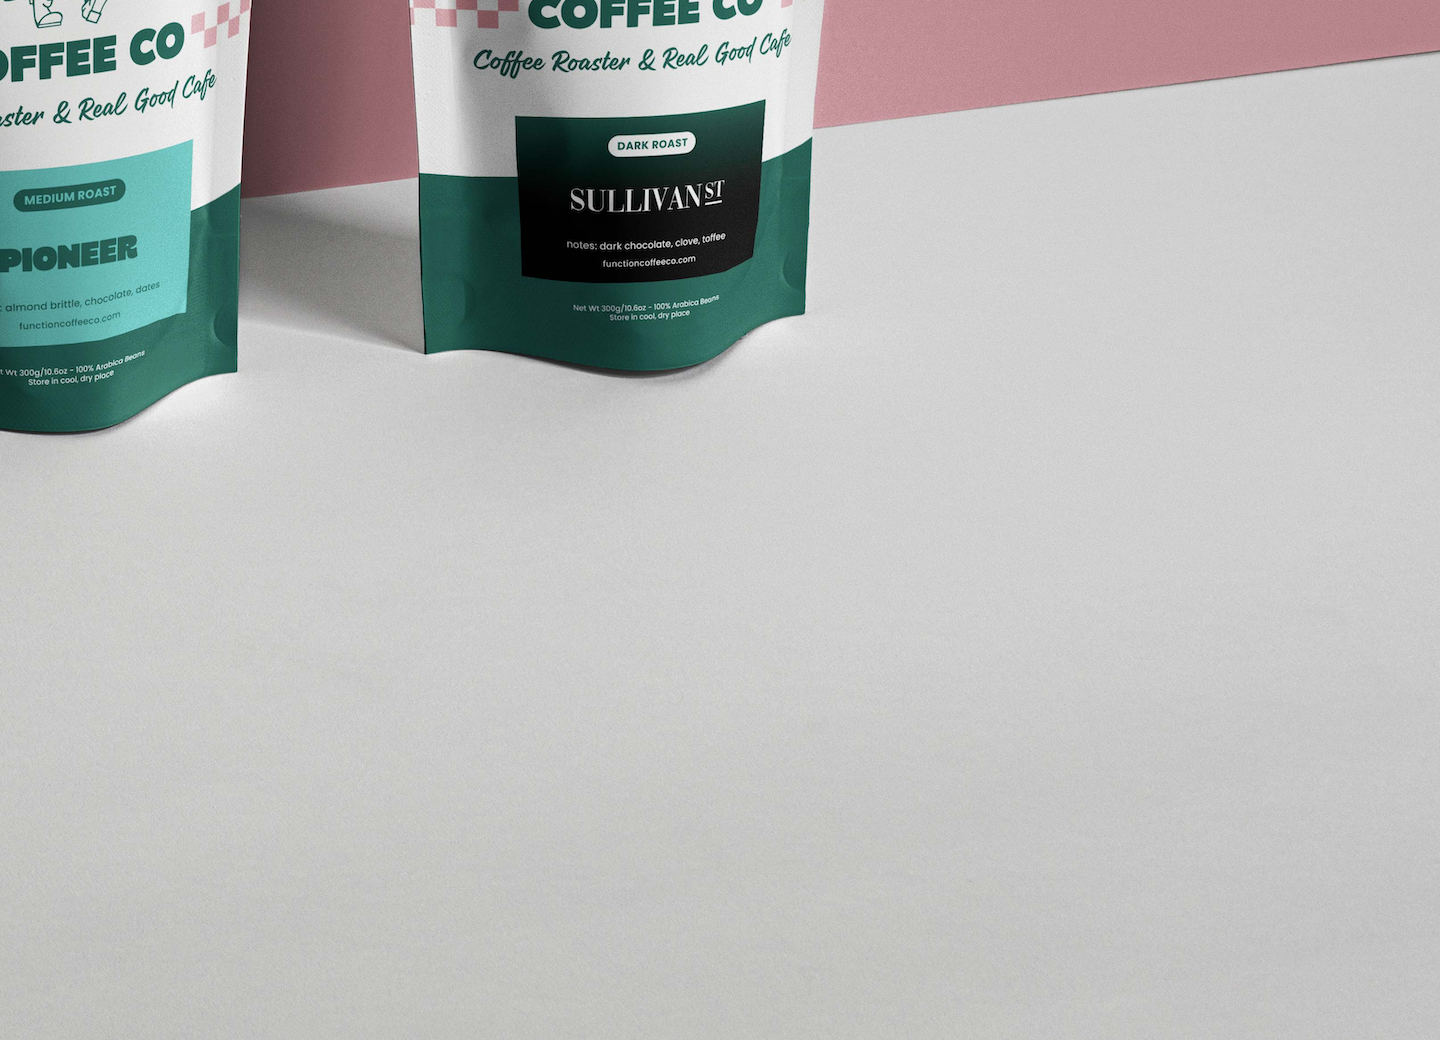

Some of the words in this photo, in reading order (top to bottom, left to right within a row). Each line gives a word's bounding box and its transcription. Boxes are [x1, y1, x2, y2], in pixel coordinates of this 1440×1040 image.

[129, 22, 185, 65] CO
[473, 49, 546, 79] Coffee
[552, 50, 631, 73] Roaster
[638, 48, 656, 70] &
[662, 44, 709, 70] Real
[715, 33, 756, 64] Good
[759, 28, 792, 58] Cafe
[52, 101, 72, 124] &
[78, 92, 128, 121] Real
[134, 80, 177, 113] Good
[182, 69, 217, 101] Cafe
[617, 141, 649, 150] DARK
[652, 138, 688, 149] ROAST
[24, 192, 75, 205] MEDIUM
[78, 186, 117, 200] ROAST
[570, 183, 703, 212] SULLIVAN
[566, 241, 597, 250] notes:
[600, 242, 622, 250] dark
[624, 240, 673, 250] chocolate,
[675, 237, 700, 247] clove,
[702, 232, 726, 243] toffee
[602, 255, 696, 268] functioncoffeeco.com
[5, 302, 47, 312] almond
[50, 300, 82, 310] brittle,
[85, 289, 133, 306] chocolate,
[136, 281, 160, 294] dates
[672, 300, 699, 309] Arabica
[700, 295, 719, 304] Beans
[19, 311, 121, 330] functioncoffeeco.com
[671, 310, 690, 318] place
[76, 364, 94, 373] 100%
[96, 357, 123, 371] Arabica
[124, 350, 145, 363] Beans
[28, 378, 49, 386] Store
[60, 376, 78, 385] cool,
[80, 374, 92, 383] dry
[94, 369, 114, 381] place
